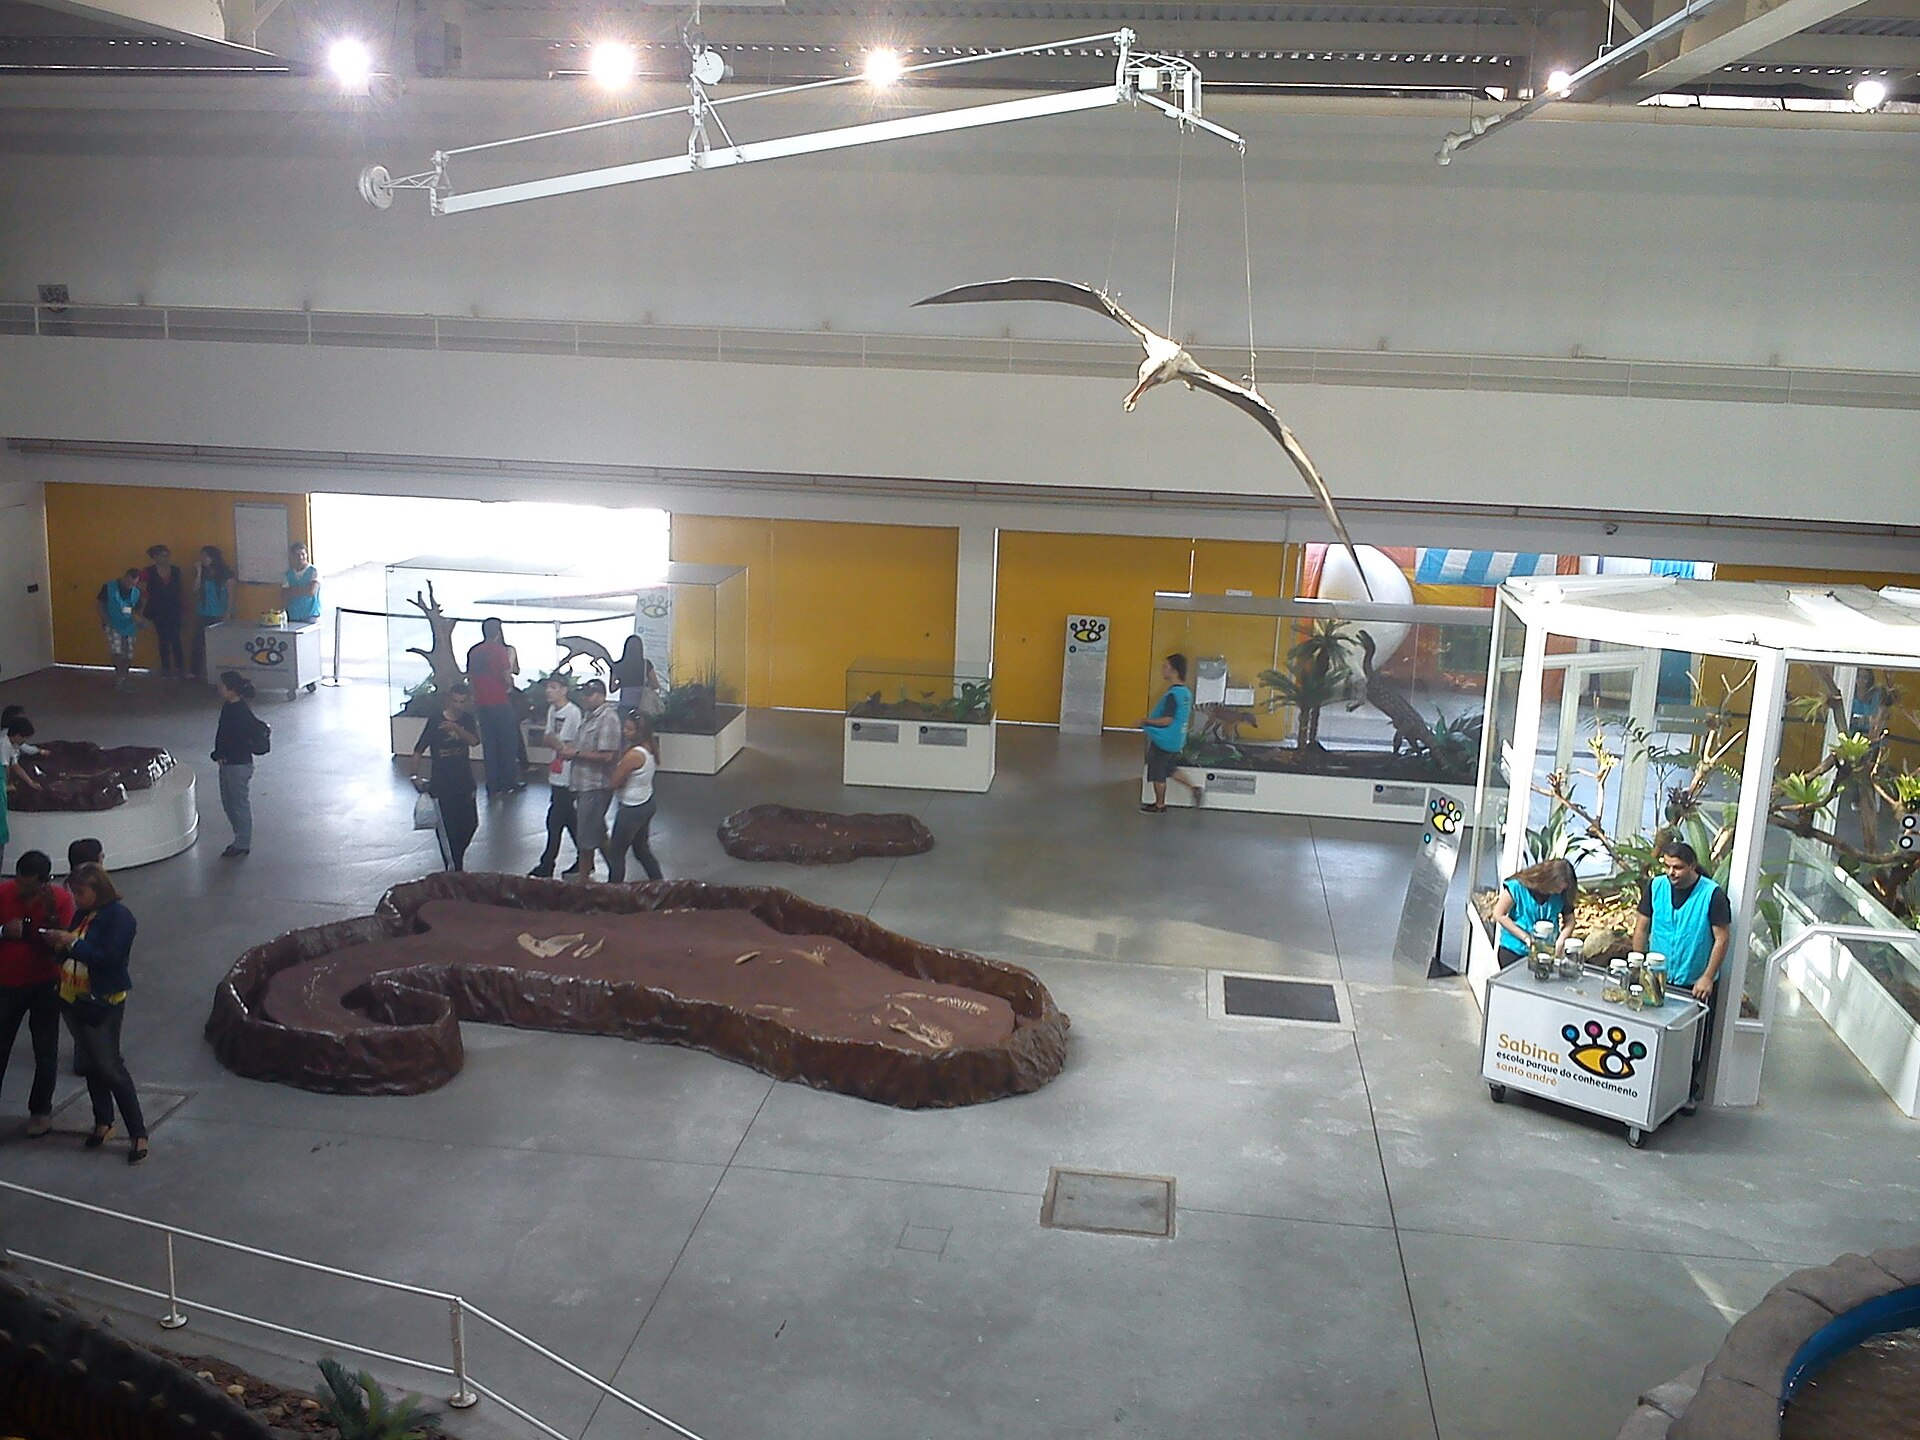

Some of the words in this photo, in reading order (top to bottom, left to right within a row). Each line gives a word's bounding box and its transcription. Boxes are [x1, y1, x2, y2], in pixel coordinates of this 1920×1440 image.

[1498, 1033, 1560, 1065] Sabina
[1496, 1062, 1524, 1076] santo
[1496, 1051, 1525, 1065] escola
[1526, 1059, 1559, 1076] parque
[1560, 1068, 1572, 1079] do
[1573, 1073, 1638, 1098] conhecimento
